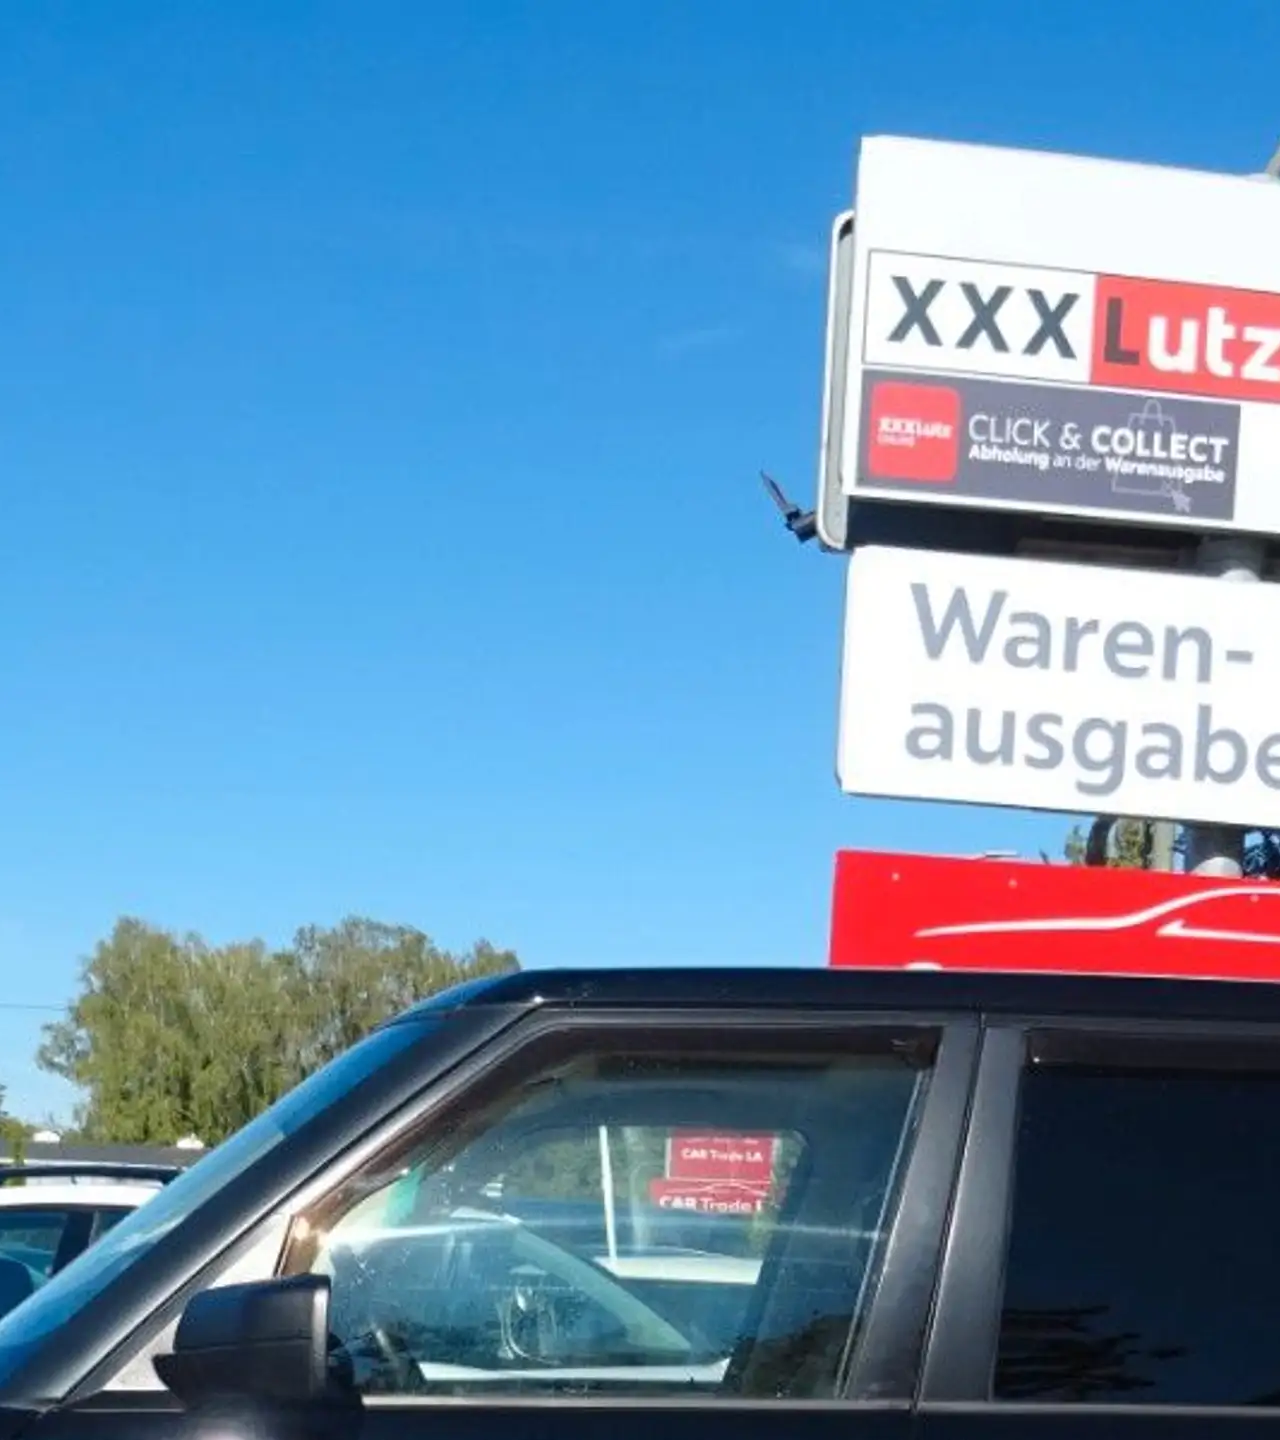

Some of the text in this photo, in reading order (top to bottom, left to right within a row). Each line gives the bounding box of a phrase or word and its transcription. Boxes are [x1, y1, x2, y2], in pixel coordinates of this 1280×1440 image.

[968, 413, 1230, 465] CLICK & COLLECT
[969, 443, 1225, 484] Abholung an der Warenausgabe
[910, 582, 1254, 684] Waren-
